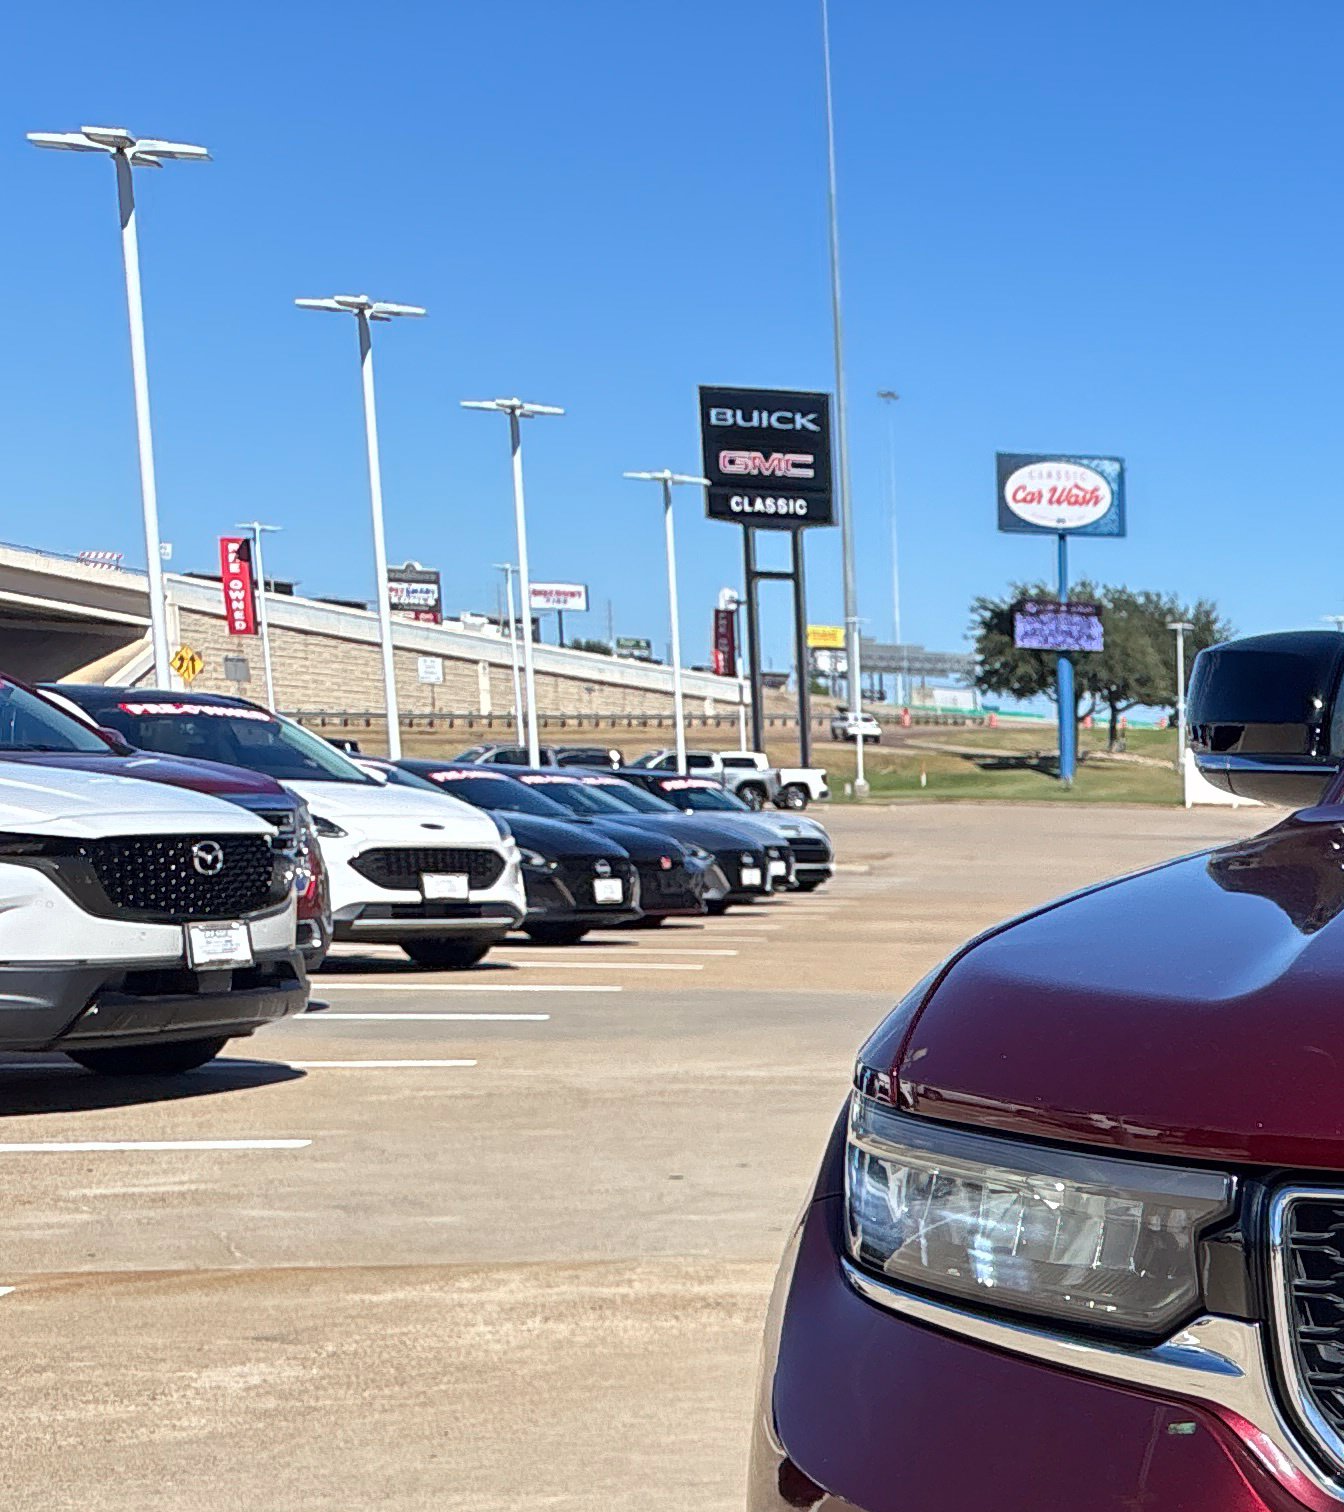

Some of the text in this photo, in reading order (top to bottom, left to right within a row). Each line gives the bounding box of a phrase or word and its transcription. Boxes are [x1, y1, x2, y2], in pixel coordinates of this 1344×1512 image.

[709, 407, 821, 432] BUICK
[719, 450, 815, 478] GMC
[730, 495, 808, 516] CLASSIC
[1012, 482, 1104, 507] Car Wash
